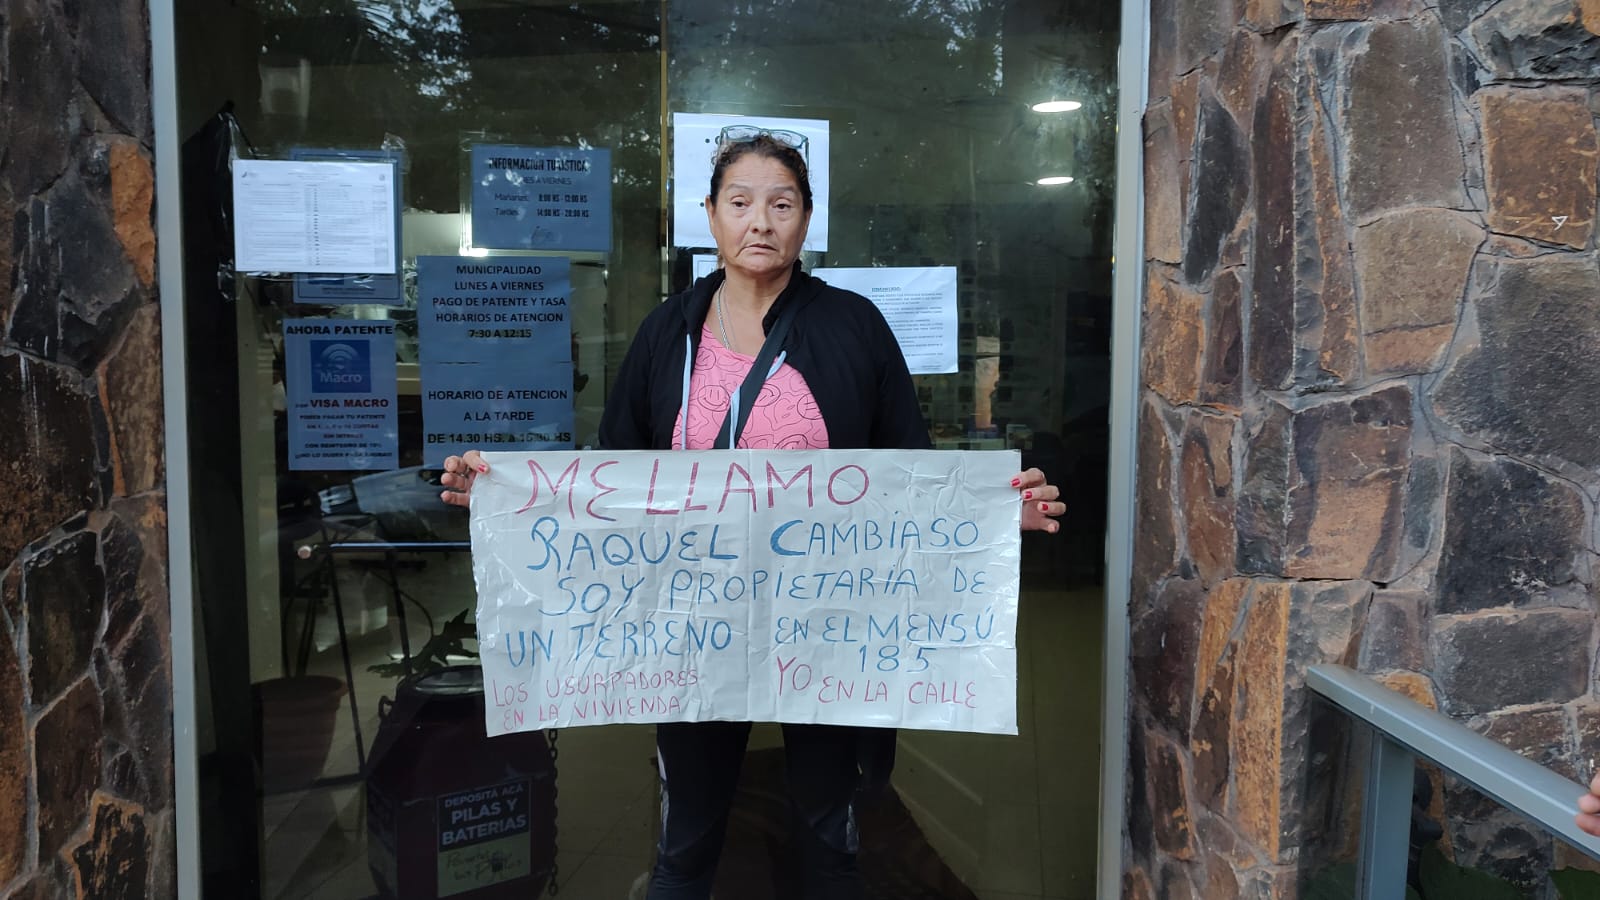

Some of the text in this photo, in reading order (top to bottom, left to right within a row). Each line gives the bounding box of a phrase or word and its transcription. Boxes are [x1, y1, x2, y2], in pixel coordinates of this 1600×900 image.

[543, 177, 572, 185] VIERNES
[456, 265, 541, 275] MUNICIPALIDAD
[454, 281, 544, 291] LUNES A VIERNES
[432, 297, 567, 307] PAGO DE PATENTE Y TASA
[436, 313, 563, 322] HORARIOS DE ATENCION
[286, 325, 393, 335] AHORA PATENTE
[468, 329, 532, 338] 7:30 A 12:15
[320, 372, 362, 383] Macro
[428, 390, 567, 400] HORARIO DE ATENCION
[310, 398, 340, 408] VISA
[343, 398, 389, 408] MACRO
[463, 411, 535, 421] A LA TARDE
[427, 433, 446, 443] DE
[449, 433, 480, 443] 14.30
[554, 432, 571, 443] HS
[526, 516, 739, 573] RAQUEL
[538, 573, 646, 619] SOY
[953, 566, 987, 595] DE
[505, 629, 554, 668] UN
[569, 620, 732, 662] TERRENO
[774, 615, 811, 645] EN
[822, 615, 859, 643] EL
[858, 644, 937, 674] 185
[776, 656, 978, 709] YO EN LA CALLE
[492, 669, 699, 708] LOS USURPADORES
[503, 695, 682, 732] EN LA VIVIENDA
[451, 797, 518, 825] PILAS Y
[441, 814, 527, 846] BATERIAS
